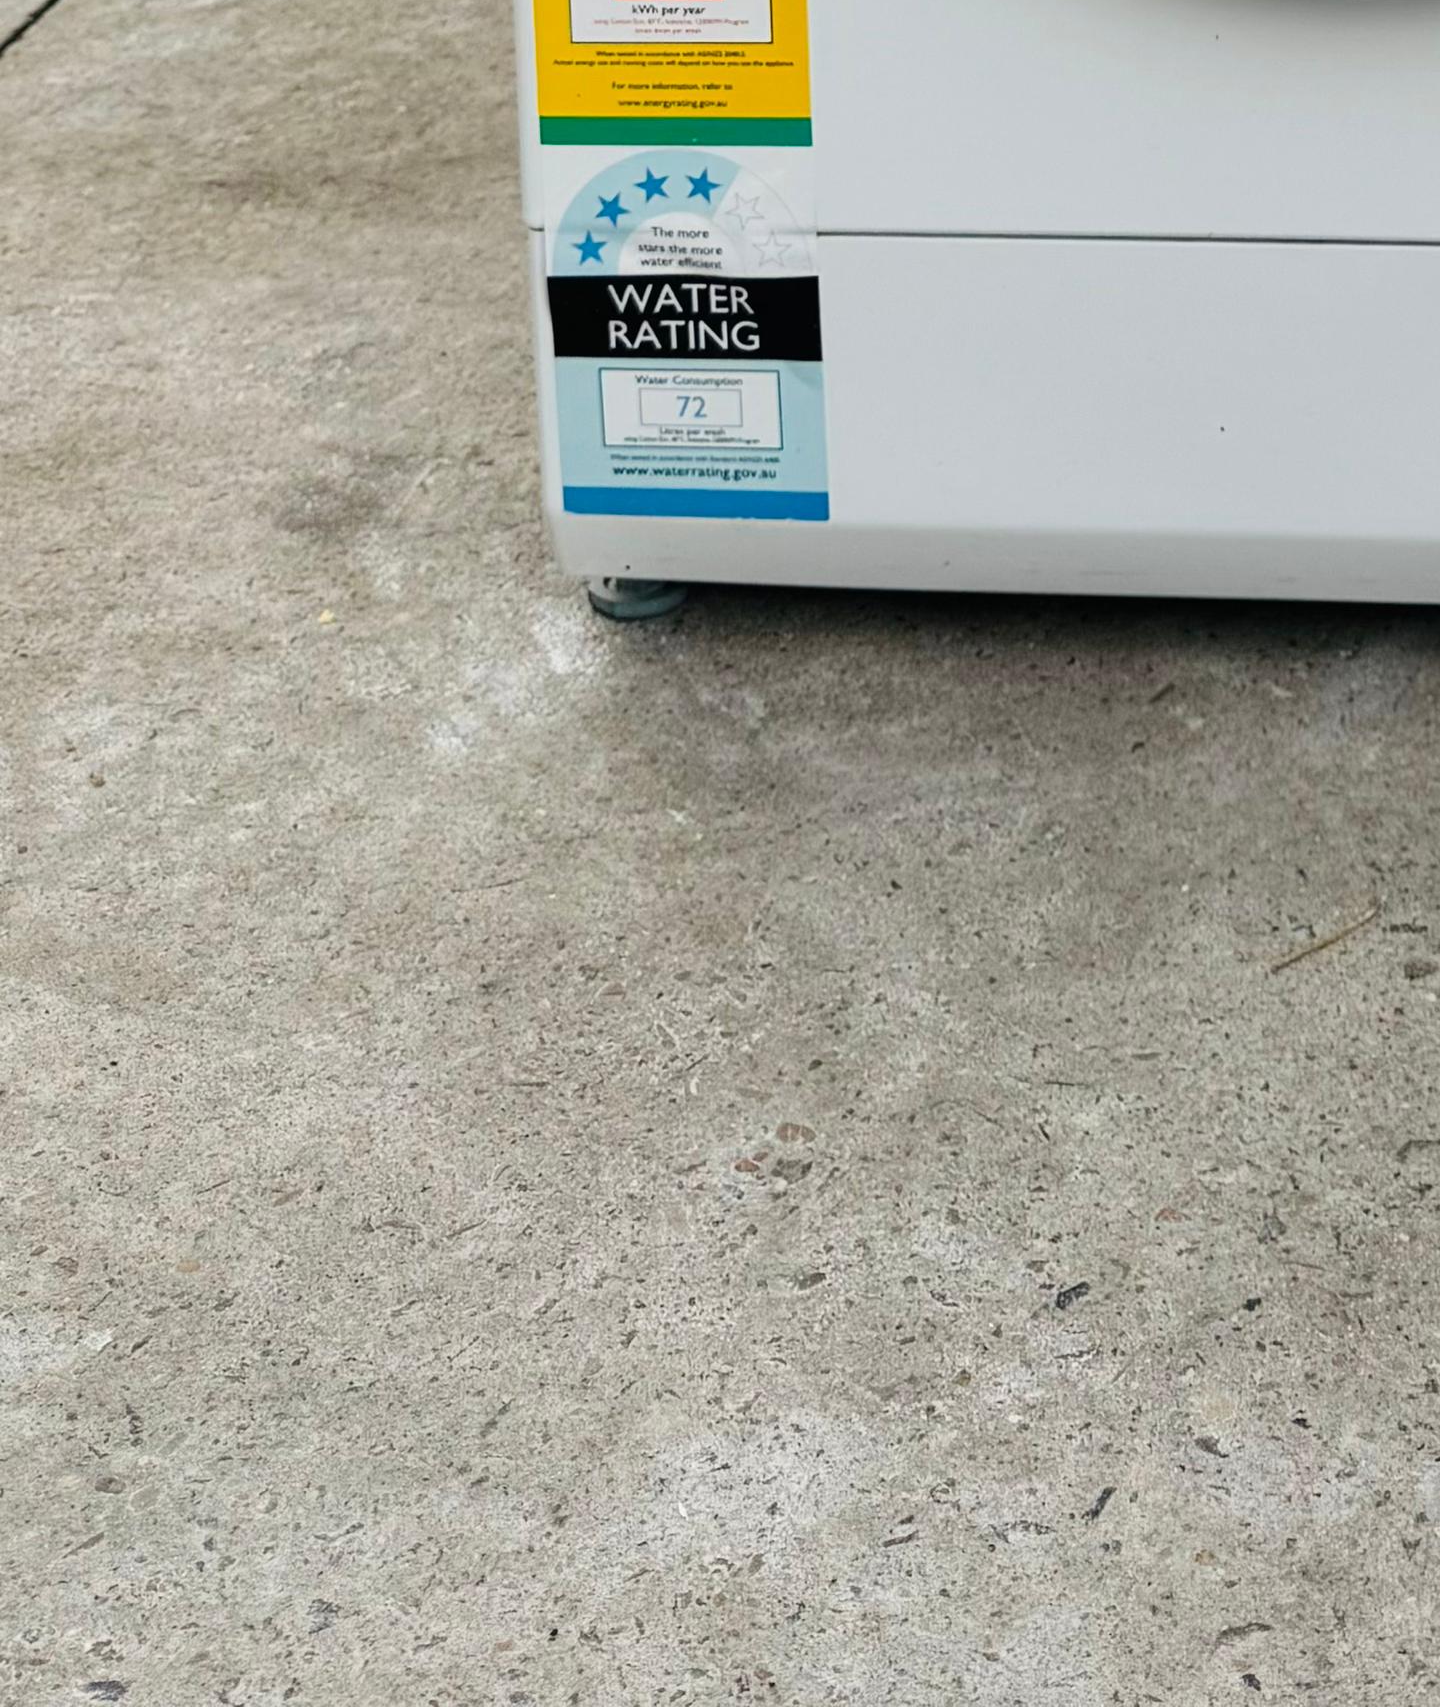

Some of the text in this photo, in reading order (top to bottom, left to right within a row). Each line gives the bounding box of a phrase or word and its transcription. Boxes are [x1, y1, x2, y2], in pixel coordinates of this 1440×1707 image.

[631, 4, 706, 17] kWh per year
[651, 226, 710, 240] The more
[669, 243, 689, 255] the
[690, 246, 723, 256] more
[640, 257, 674, 268] water
[606, 282, 755, 316] WATER
[607, 319, 761, 353] RATING
[634, 374, 669, 386] Water
[675, 395, 708, 419] 72
[612, 463, 778, 483] www.waterrating.gov.au
